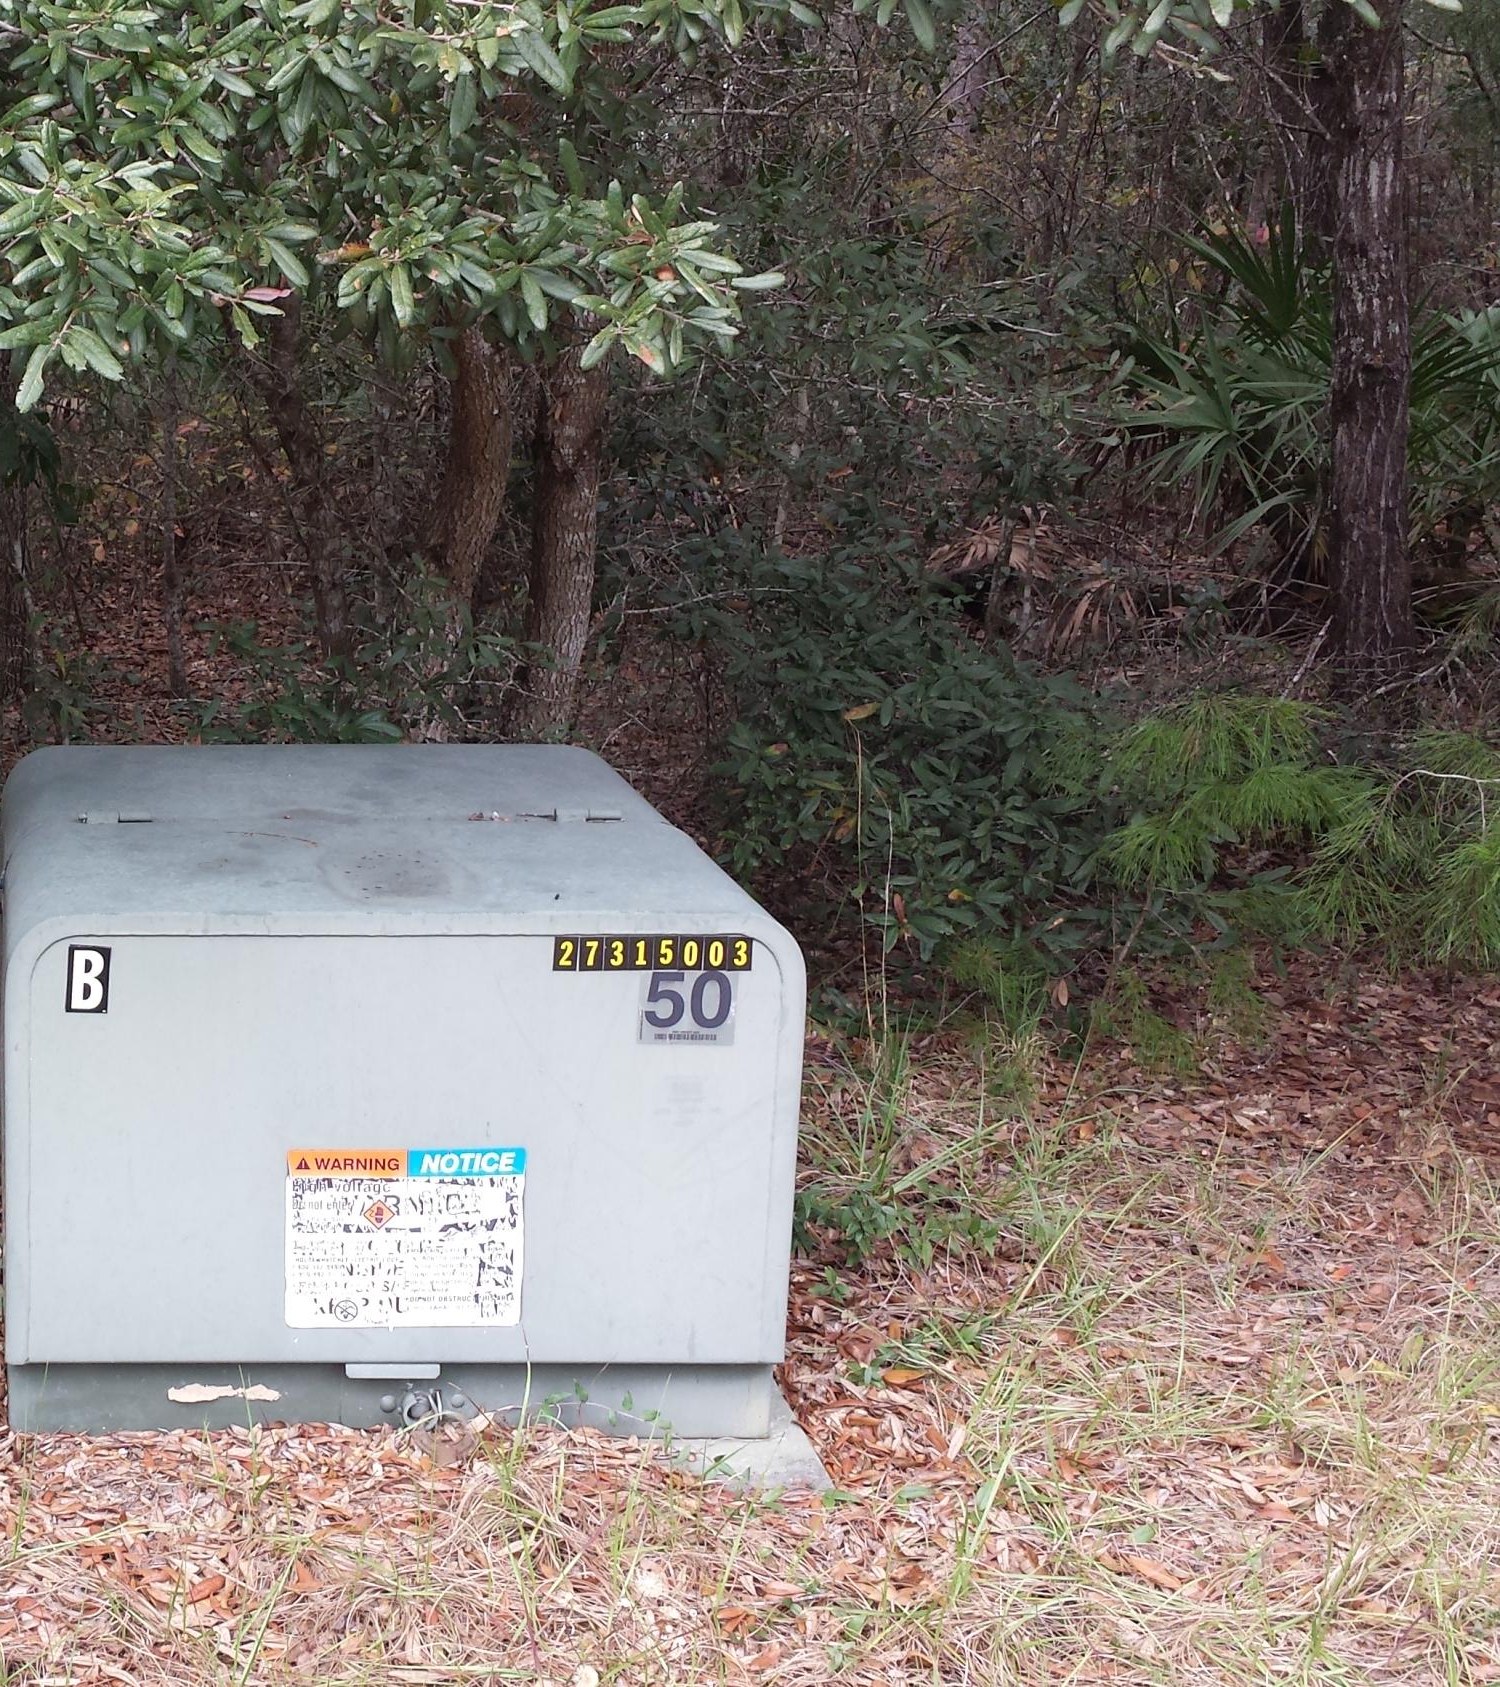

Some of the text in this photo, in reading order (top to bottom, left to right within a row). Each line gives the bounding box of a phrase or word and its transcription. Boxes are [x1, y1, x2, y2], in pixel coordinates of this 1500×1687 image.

[558, 940, 748, 967] 27315003
[71, 949, 105, 1010] B
[644, 970, 732, 1029] 50
[315, 1157, 400, 1171] WARNING
[420, 1152, 516, 1174] NOTICE
